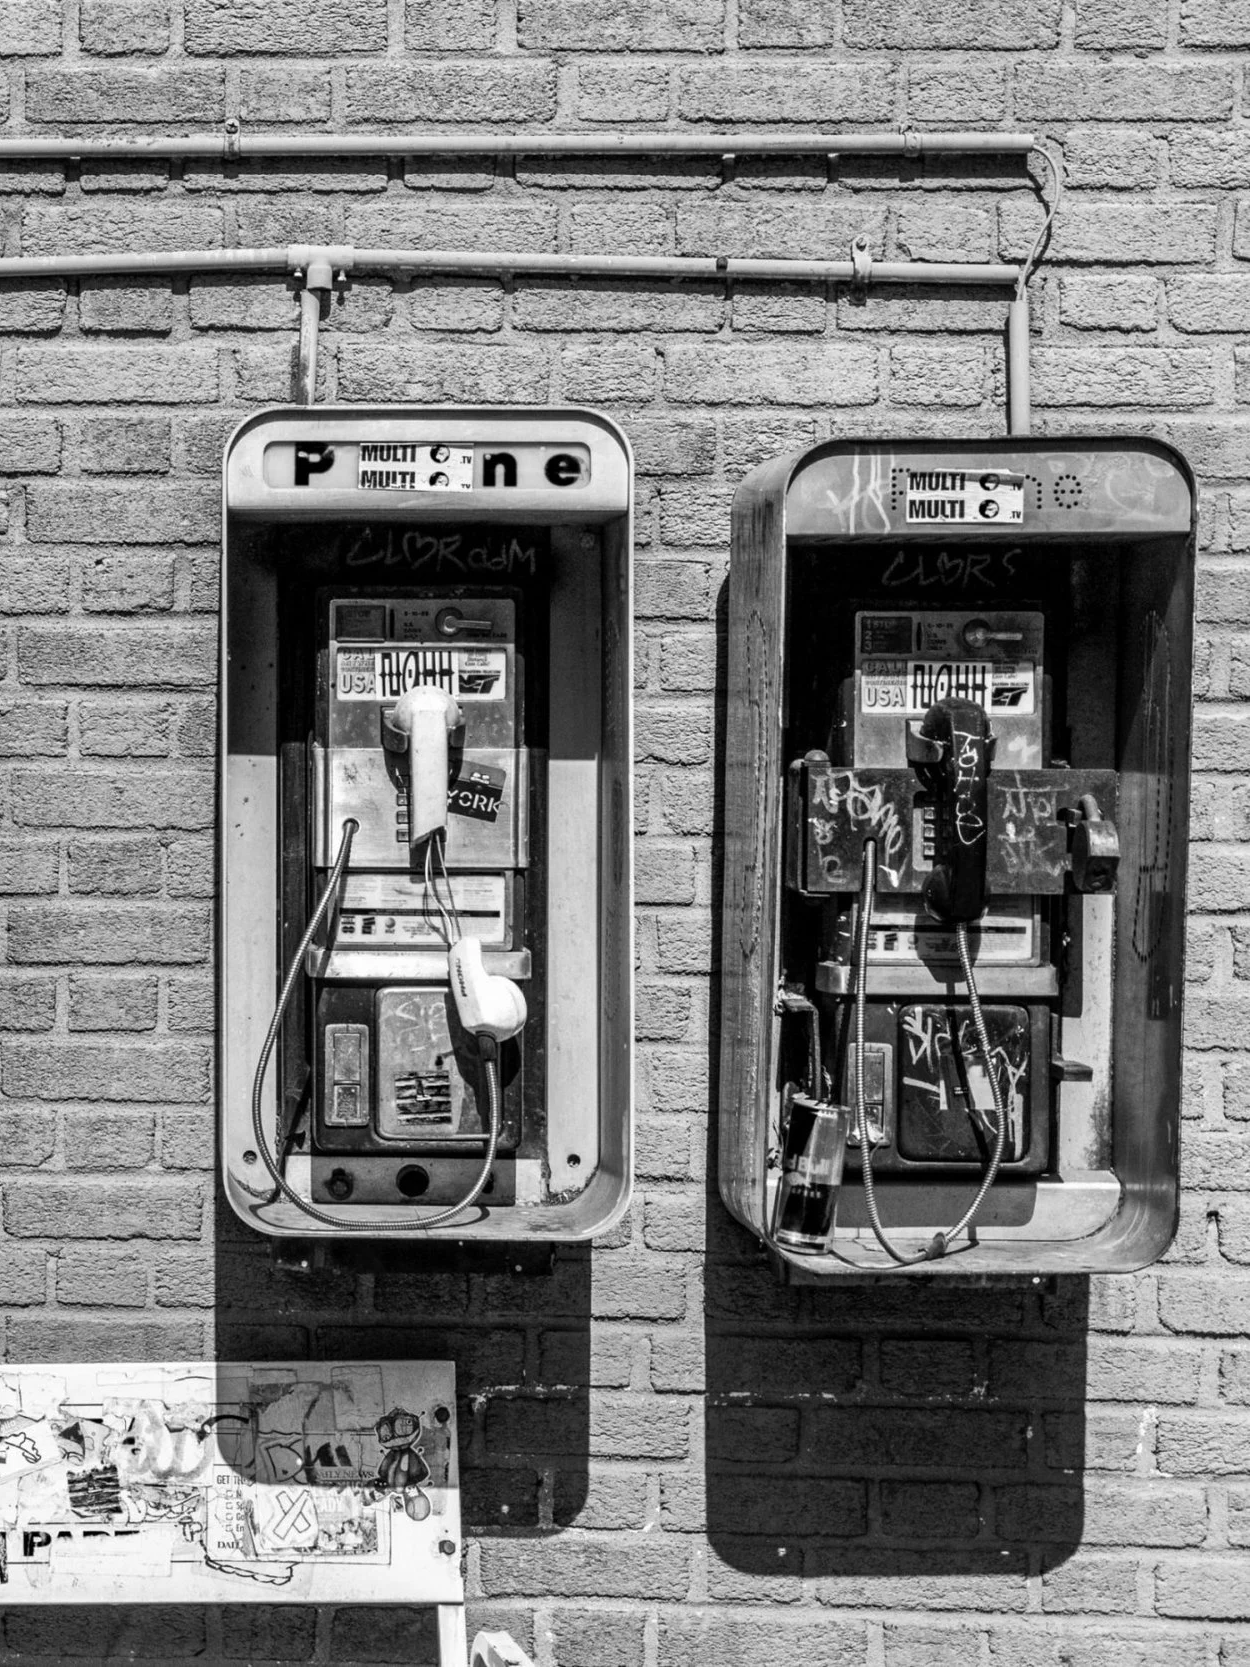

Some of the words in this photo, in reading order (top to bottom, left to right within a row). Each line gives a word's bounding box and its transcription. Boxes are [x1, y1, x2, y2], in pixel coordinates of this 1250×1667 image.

[361, 444, 417, 463] MULTI
[361, 470, 416, 489] MULTI
[909, 472, 966, 491] MULTI
[908, 499, 966, 519] MULTI
[1010, 511, 1022, 519] .TV
[340, 673, 377, 694] USA
[866, 687, 906, 708] USA
[446, 789, 501, 813] YORK
[216, 1474, 231, 1485] GET
